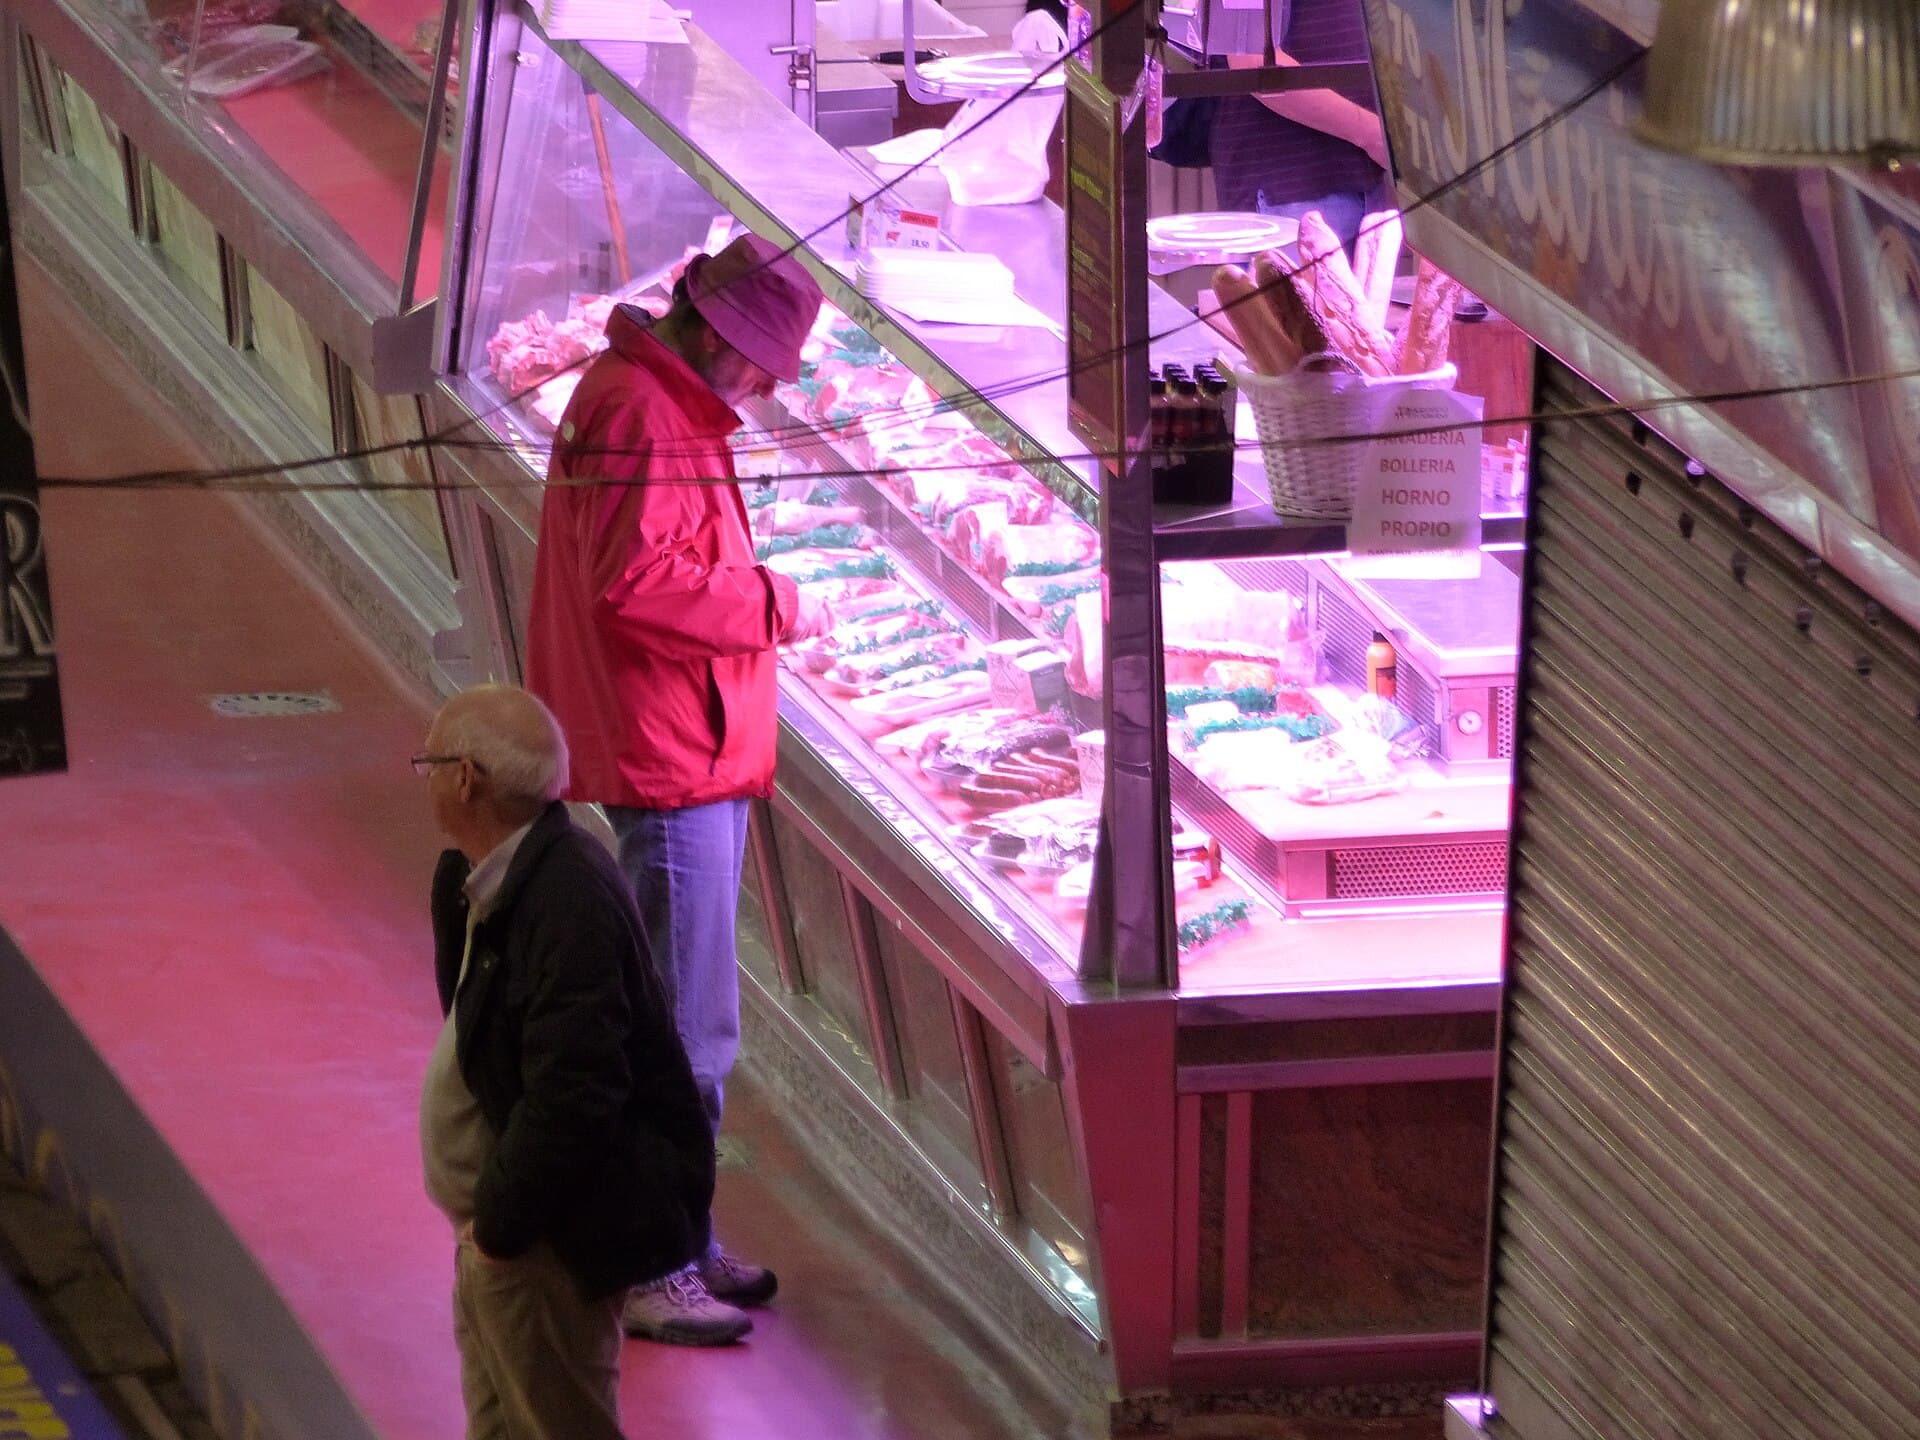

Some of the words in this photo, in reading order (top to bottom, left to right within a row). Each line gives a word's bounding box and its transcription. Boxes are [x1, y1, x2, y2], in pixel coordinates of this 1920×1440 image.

[1379, 458, 1456, 474] BOLLERIA
[1381, 489, 1451, 506] HORNO
[1380, 520, 1451, 538] PROPIO
